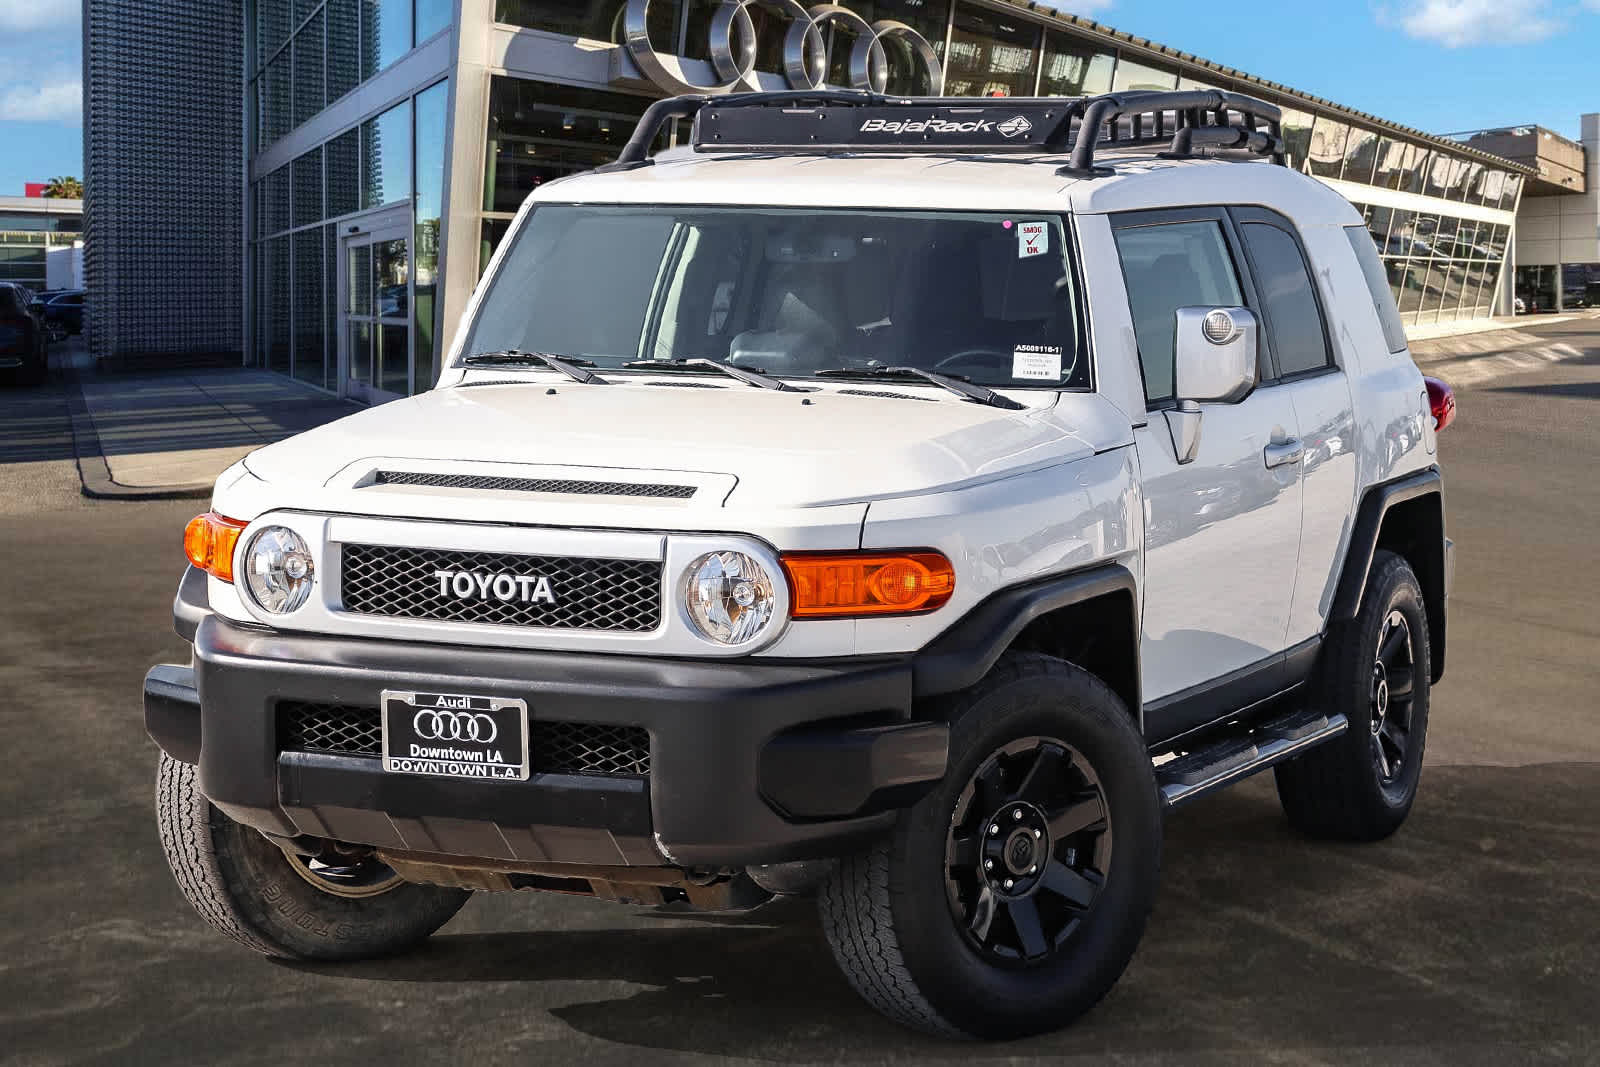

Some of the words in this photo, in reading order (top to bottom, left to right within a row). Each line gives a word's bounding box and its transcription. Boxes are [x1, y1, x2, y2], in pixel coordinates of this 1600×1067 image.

[859, 119, 996, 135] BajaRack
[1023, 226, 1042, 234] SMOG
[1026, 246, 1039, 254] OK
[434, 570, 556, 604] TOYOTA
[435, 695, 471, 709] Audi
[410, 743, 484, 762] Downtown
[486, 749, 503, 763] LA
[390, 759, 487, 777] DOWNTOWN
[491, 766, 520, 778] L.A.
